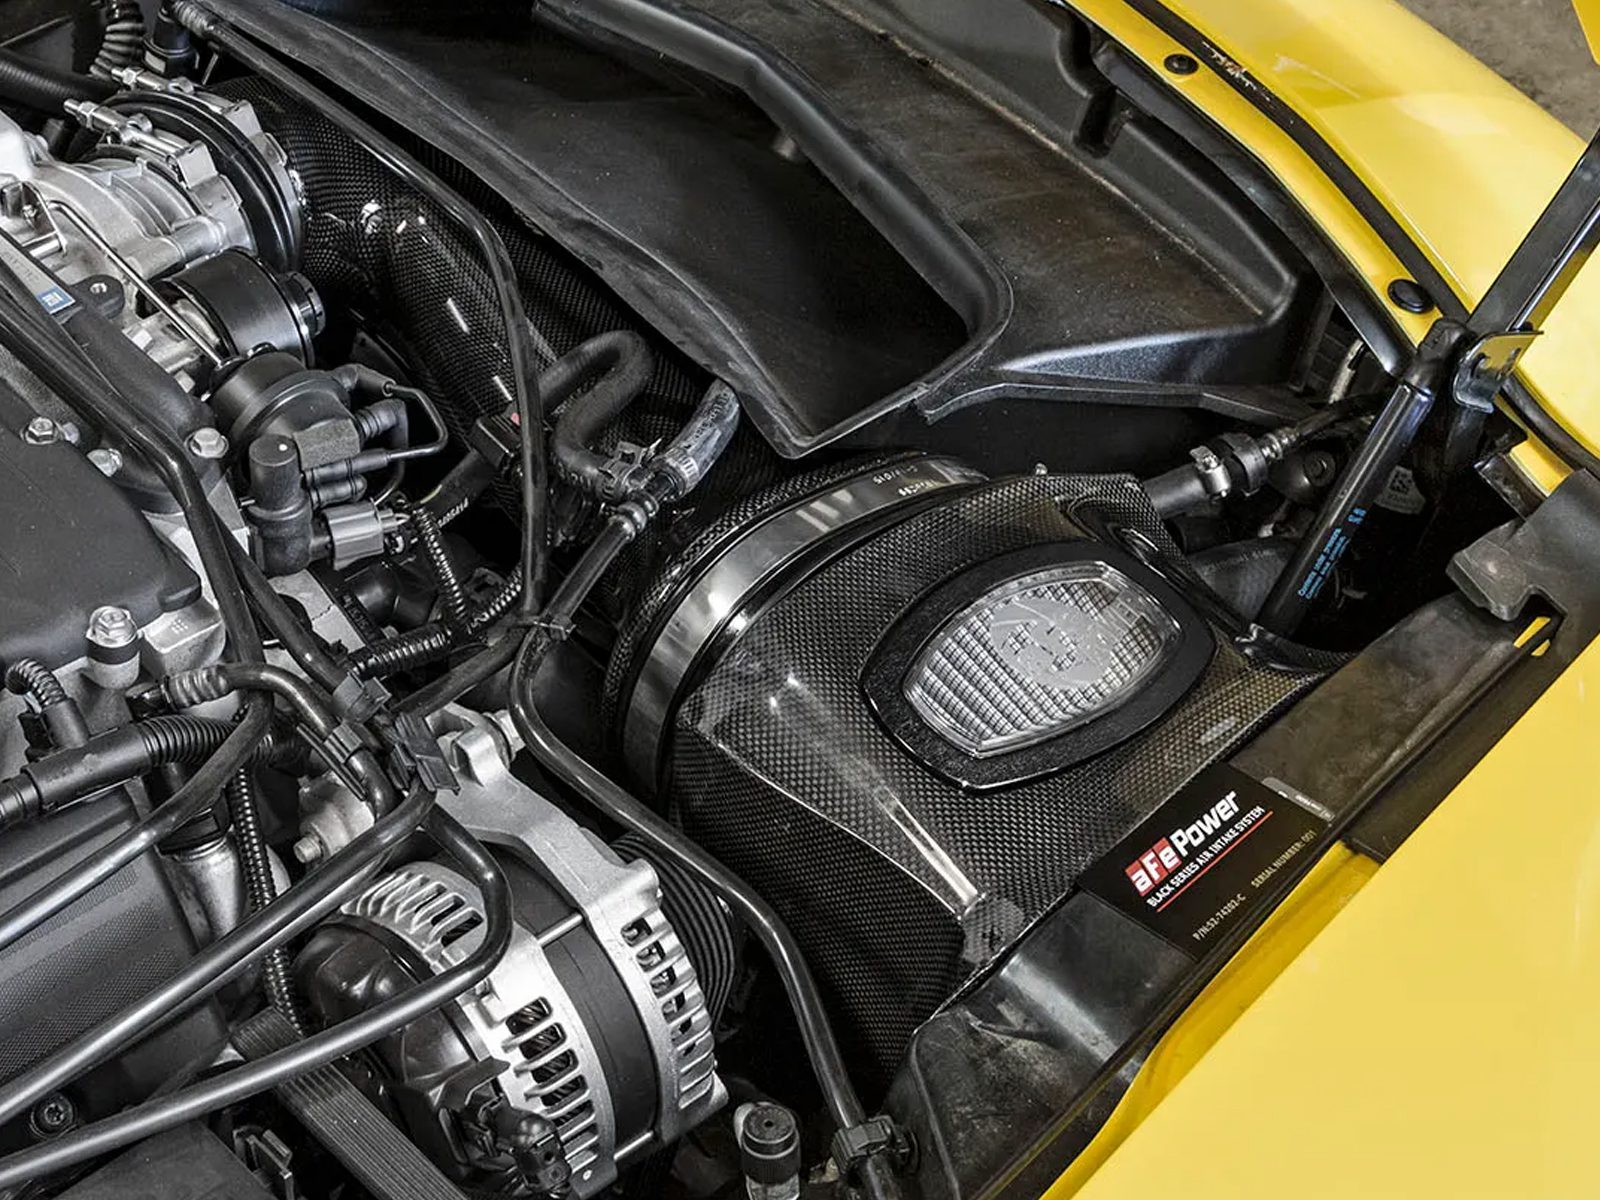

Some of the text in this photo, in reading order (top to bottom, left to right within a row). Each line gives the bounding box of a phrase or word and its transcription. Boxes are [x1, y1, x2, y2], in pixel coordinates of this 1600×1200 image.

[1146, 883, 1175, 907] BLACK
[1169, 861, 1200, 887] SERIES
[1195, 848, 1214, 867] AIR
[1208, 827, 1239, 854] INTAKE
[1234, 805, 1266, 832] SYSTEM
[1169, 791, 1240, 857] Power
[1251, 866, 1277, 888] SERIAL
